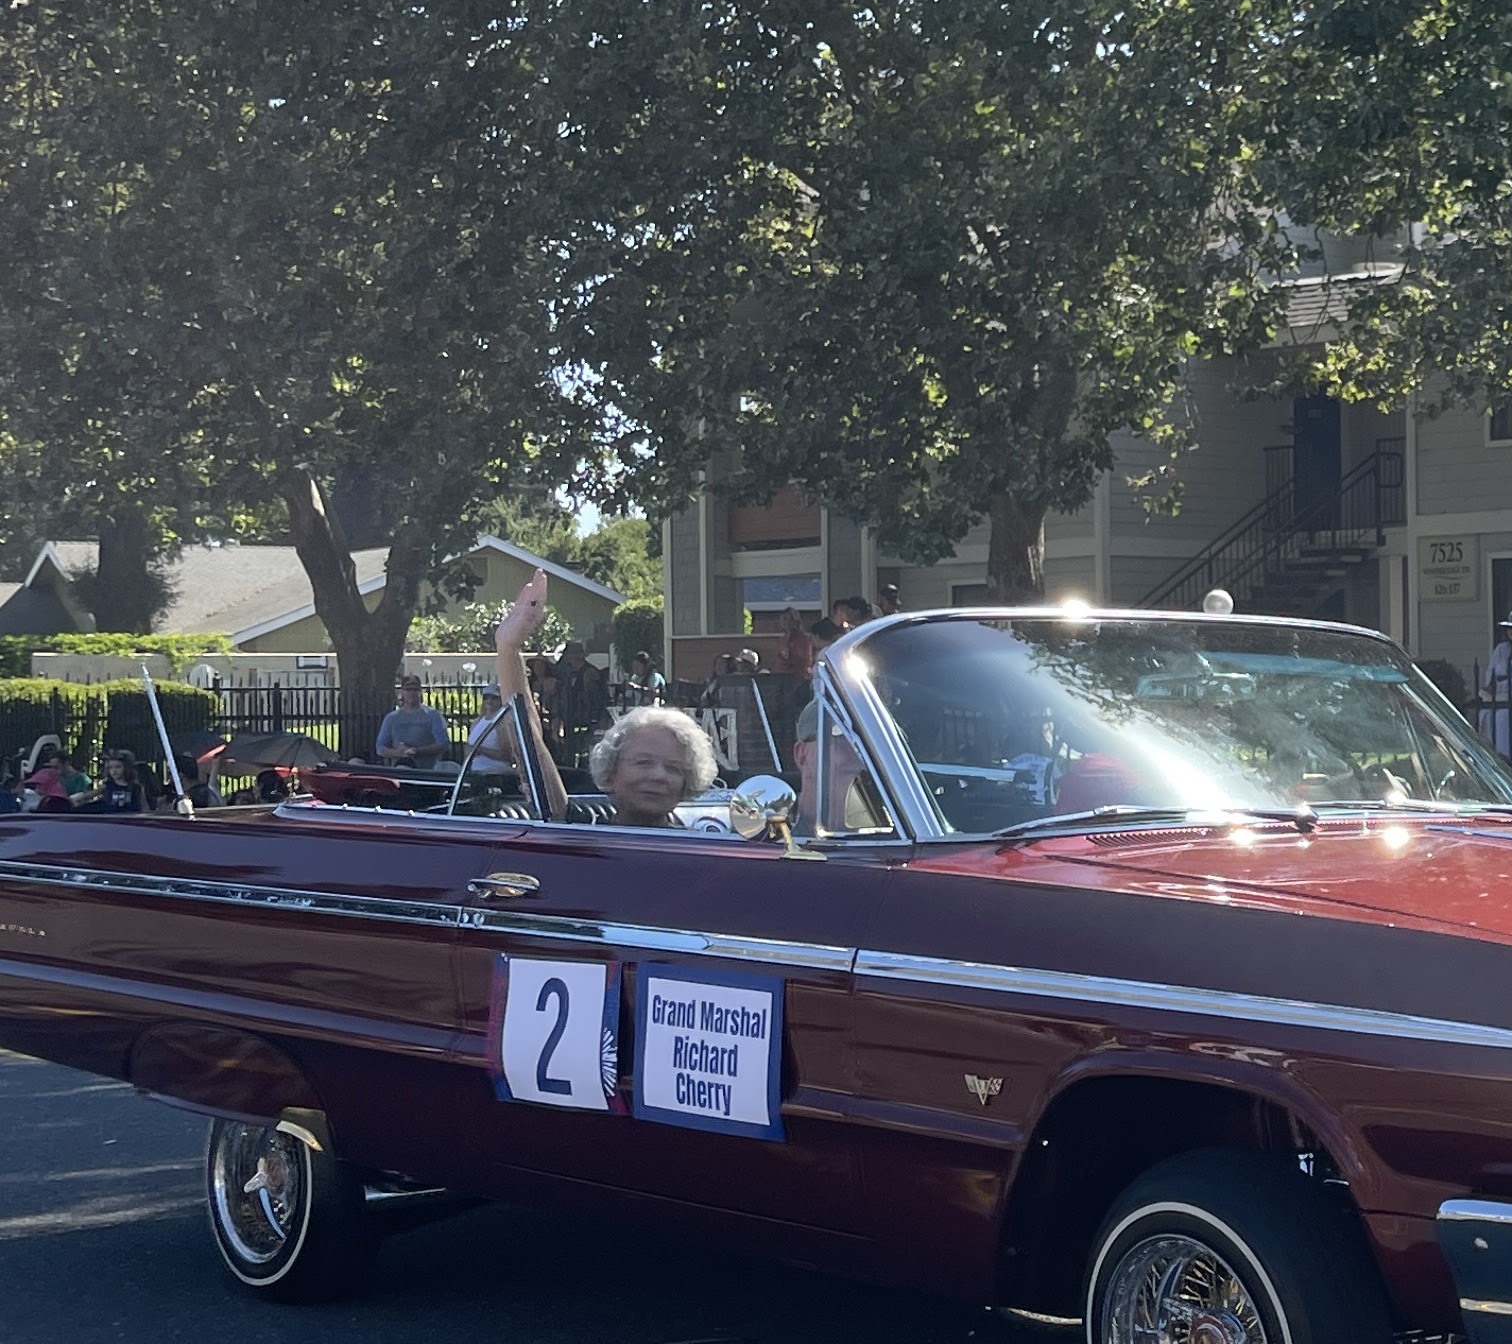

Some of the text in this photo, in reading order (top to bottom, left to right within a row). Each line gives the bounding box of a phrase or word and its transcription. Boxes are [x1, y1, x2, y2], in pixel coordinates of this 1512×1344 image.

[1430, 541, 1463, 563] 7525
[535, 977, 573, 1096] 2
[652, 993, 767, 1039] Grand Marshal
[673, 1035, 738, 1078] Richard
[676, 1072, 732, 1116] Cherry
